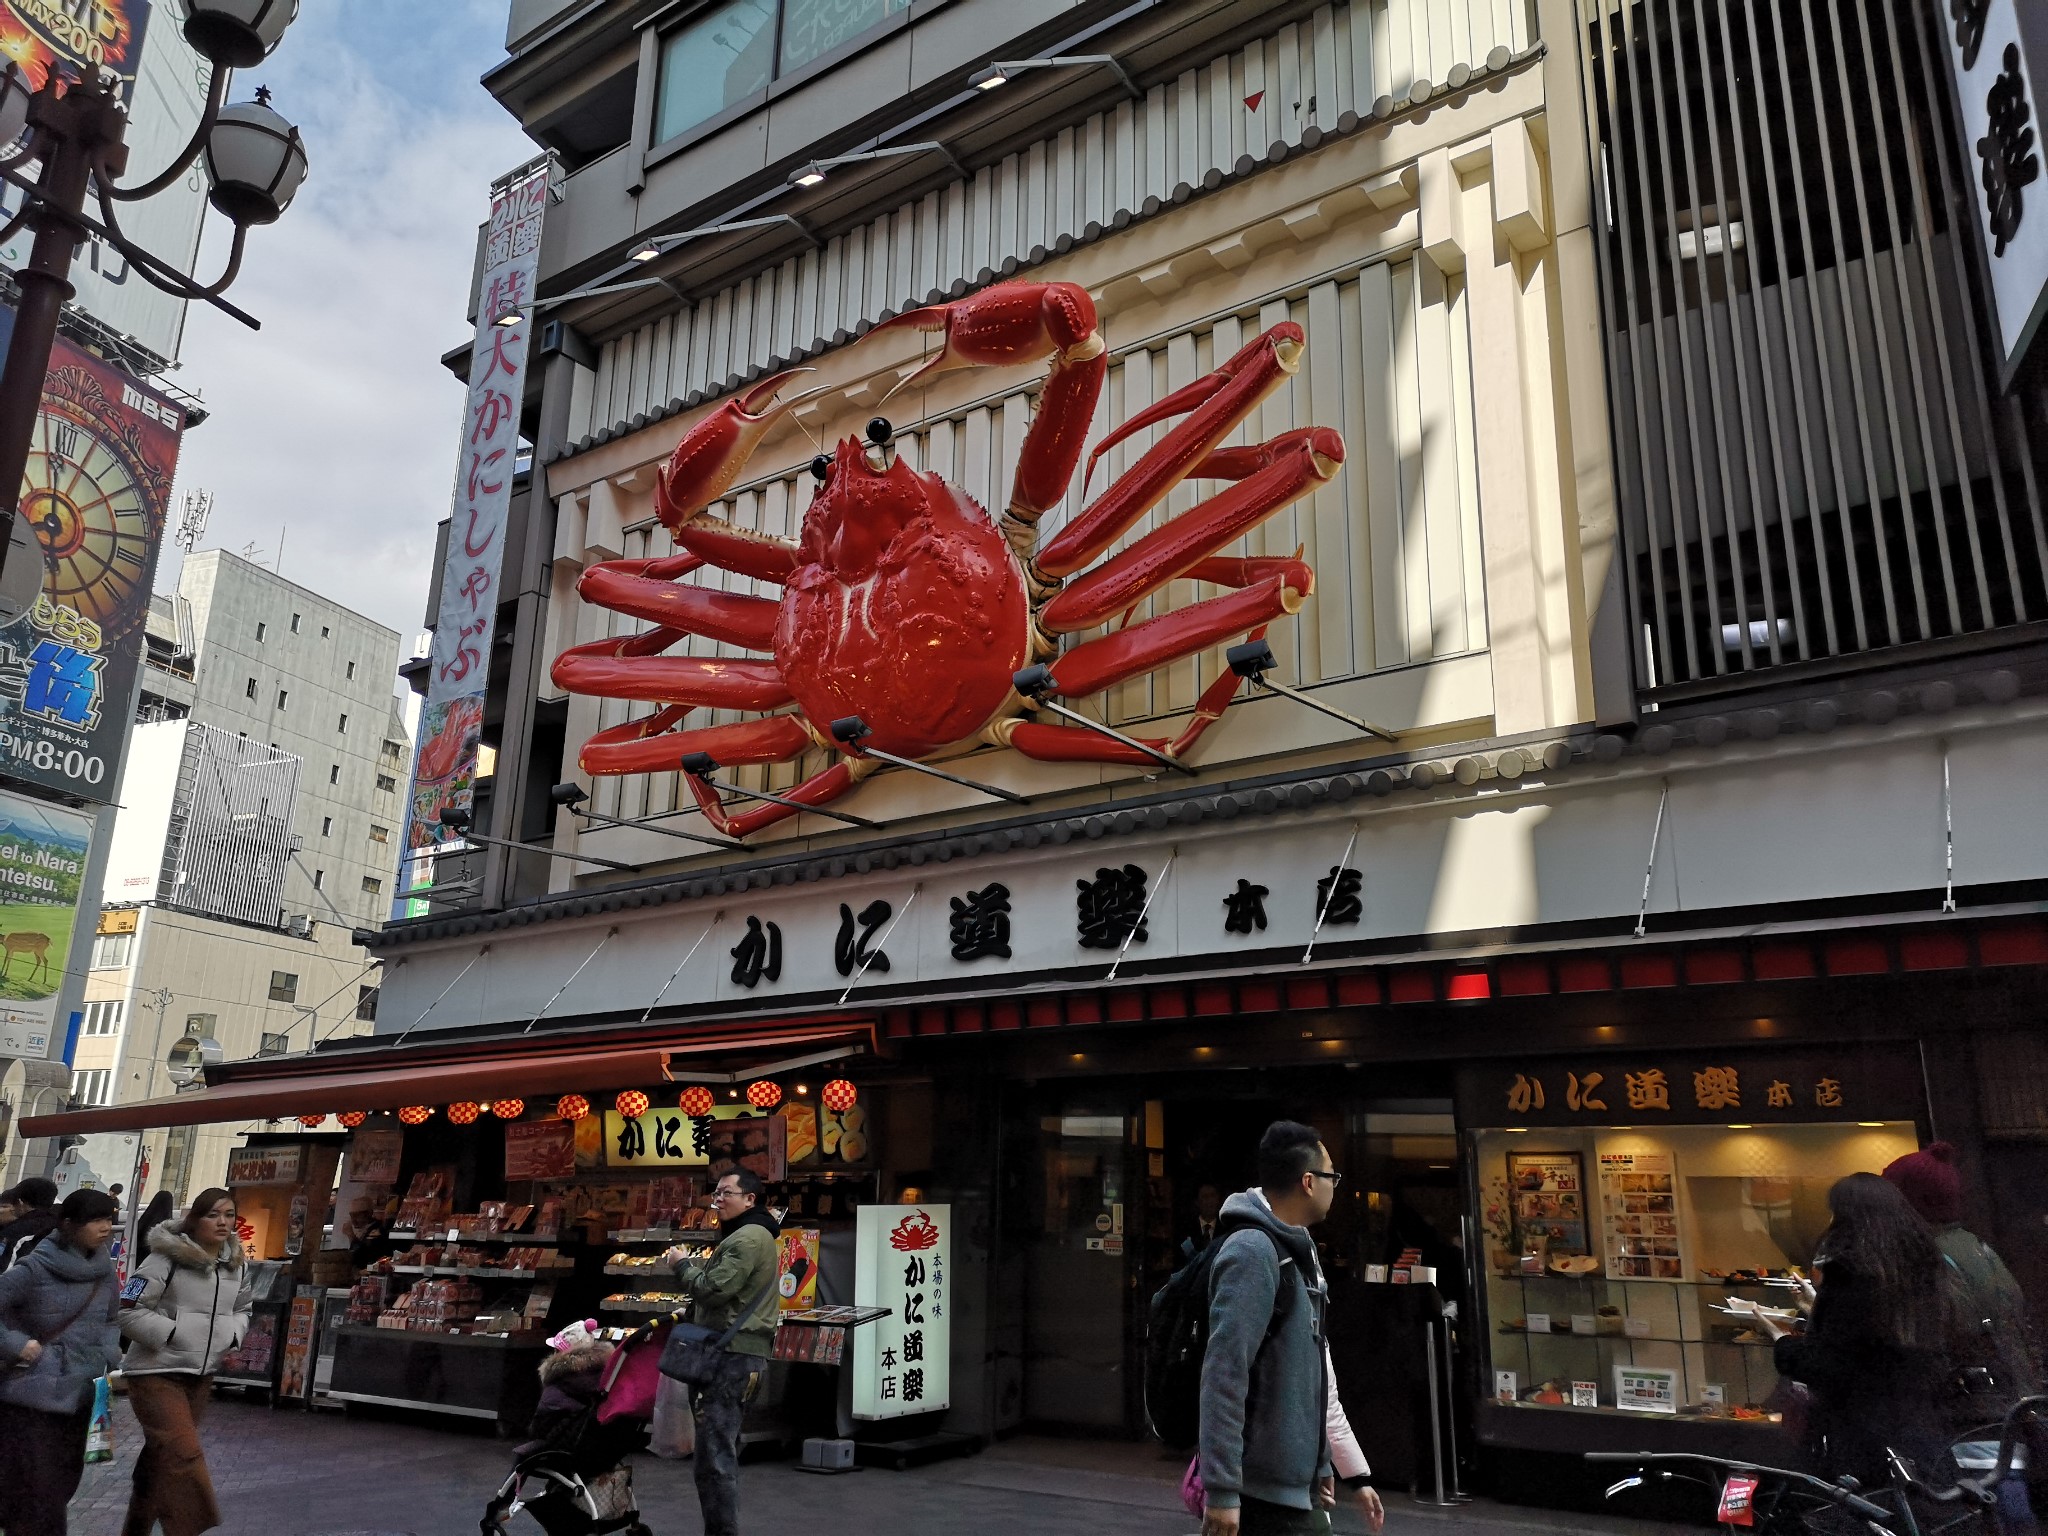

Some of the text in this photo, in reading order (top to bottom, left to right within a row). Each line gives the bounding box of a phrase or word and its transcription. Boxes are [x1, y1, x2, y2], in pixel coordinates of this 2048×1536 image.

[440, 271, 526, 682] 特大かにしゃぶ
[21, 852, 33, 864] to
[35, 850, 77, 875] Nara
[931, 1252, 944, 1320] 本場の味
[880, 1347, 898, 1401] 本店
